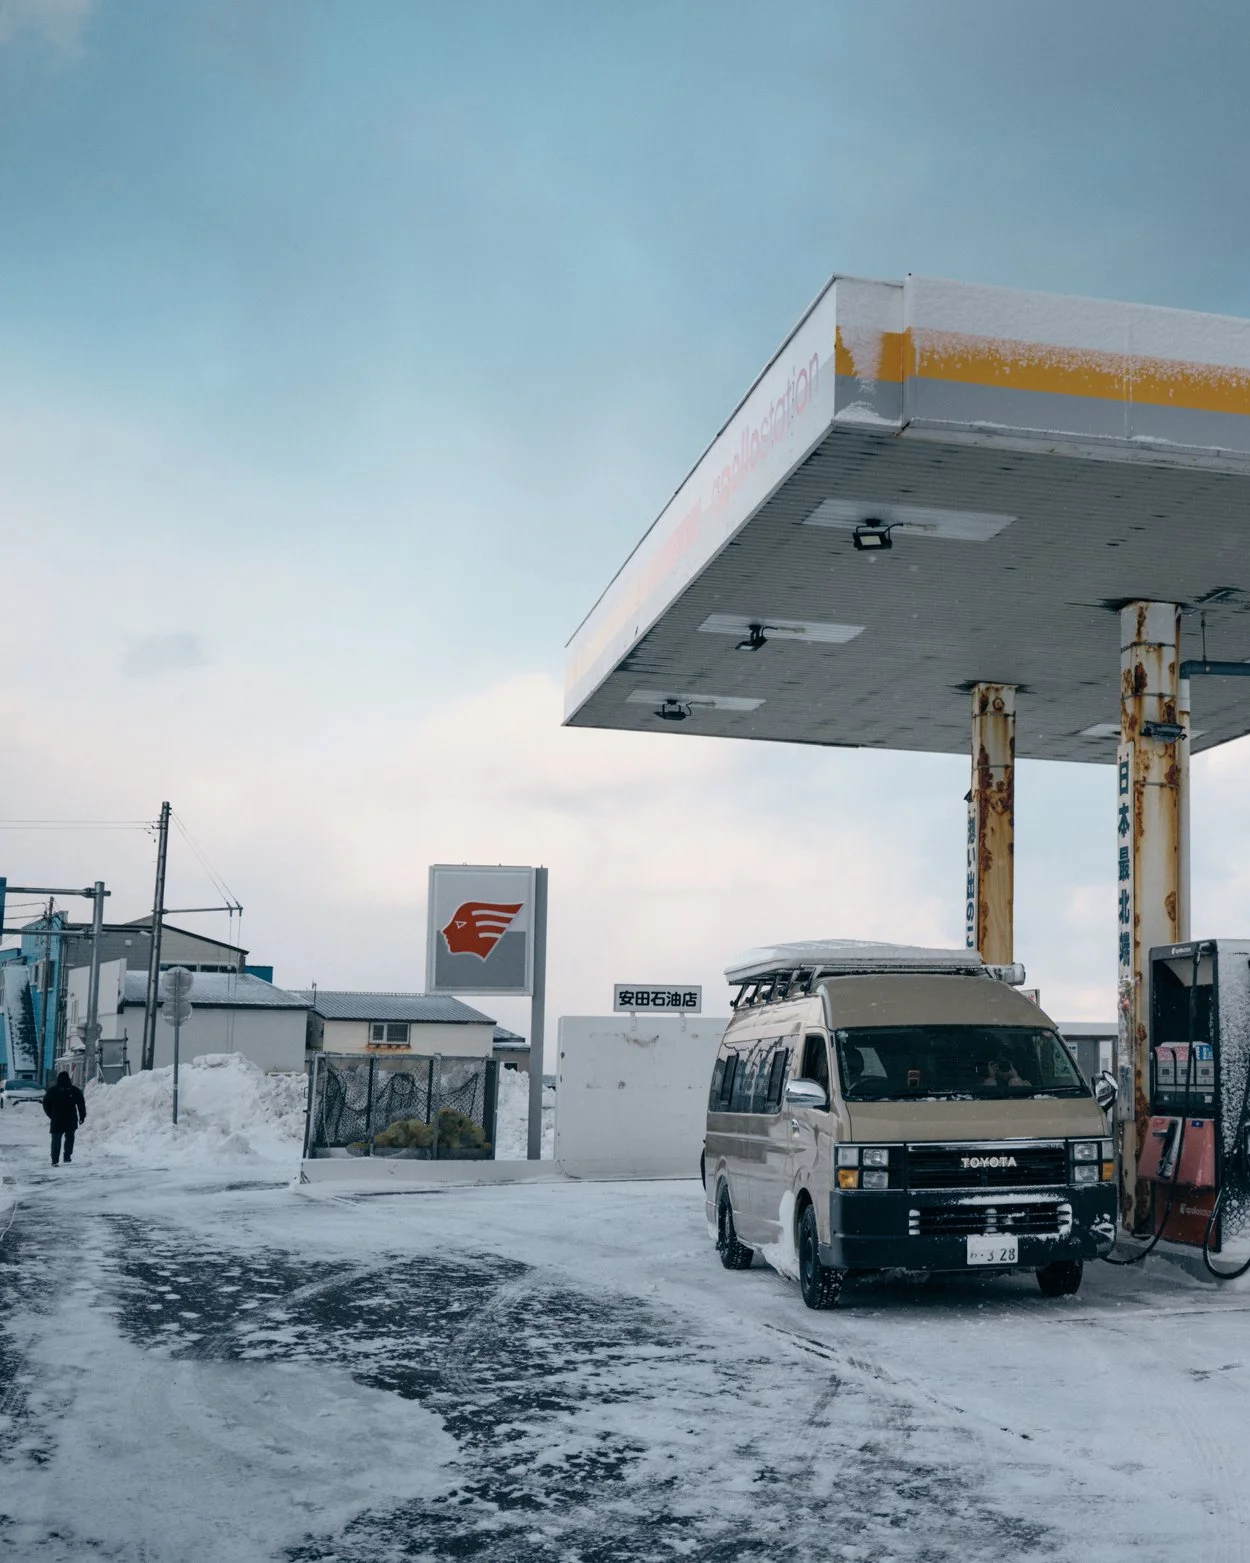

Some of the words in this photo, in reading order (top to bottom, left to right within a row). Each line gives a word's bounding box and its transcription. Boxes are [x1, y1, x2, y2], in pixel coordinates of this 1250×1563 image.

[619, 990, 697, 1007] 安田石油店
[961, 1156, 1017, 1169] TOYOTA
